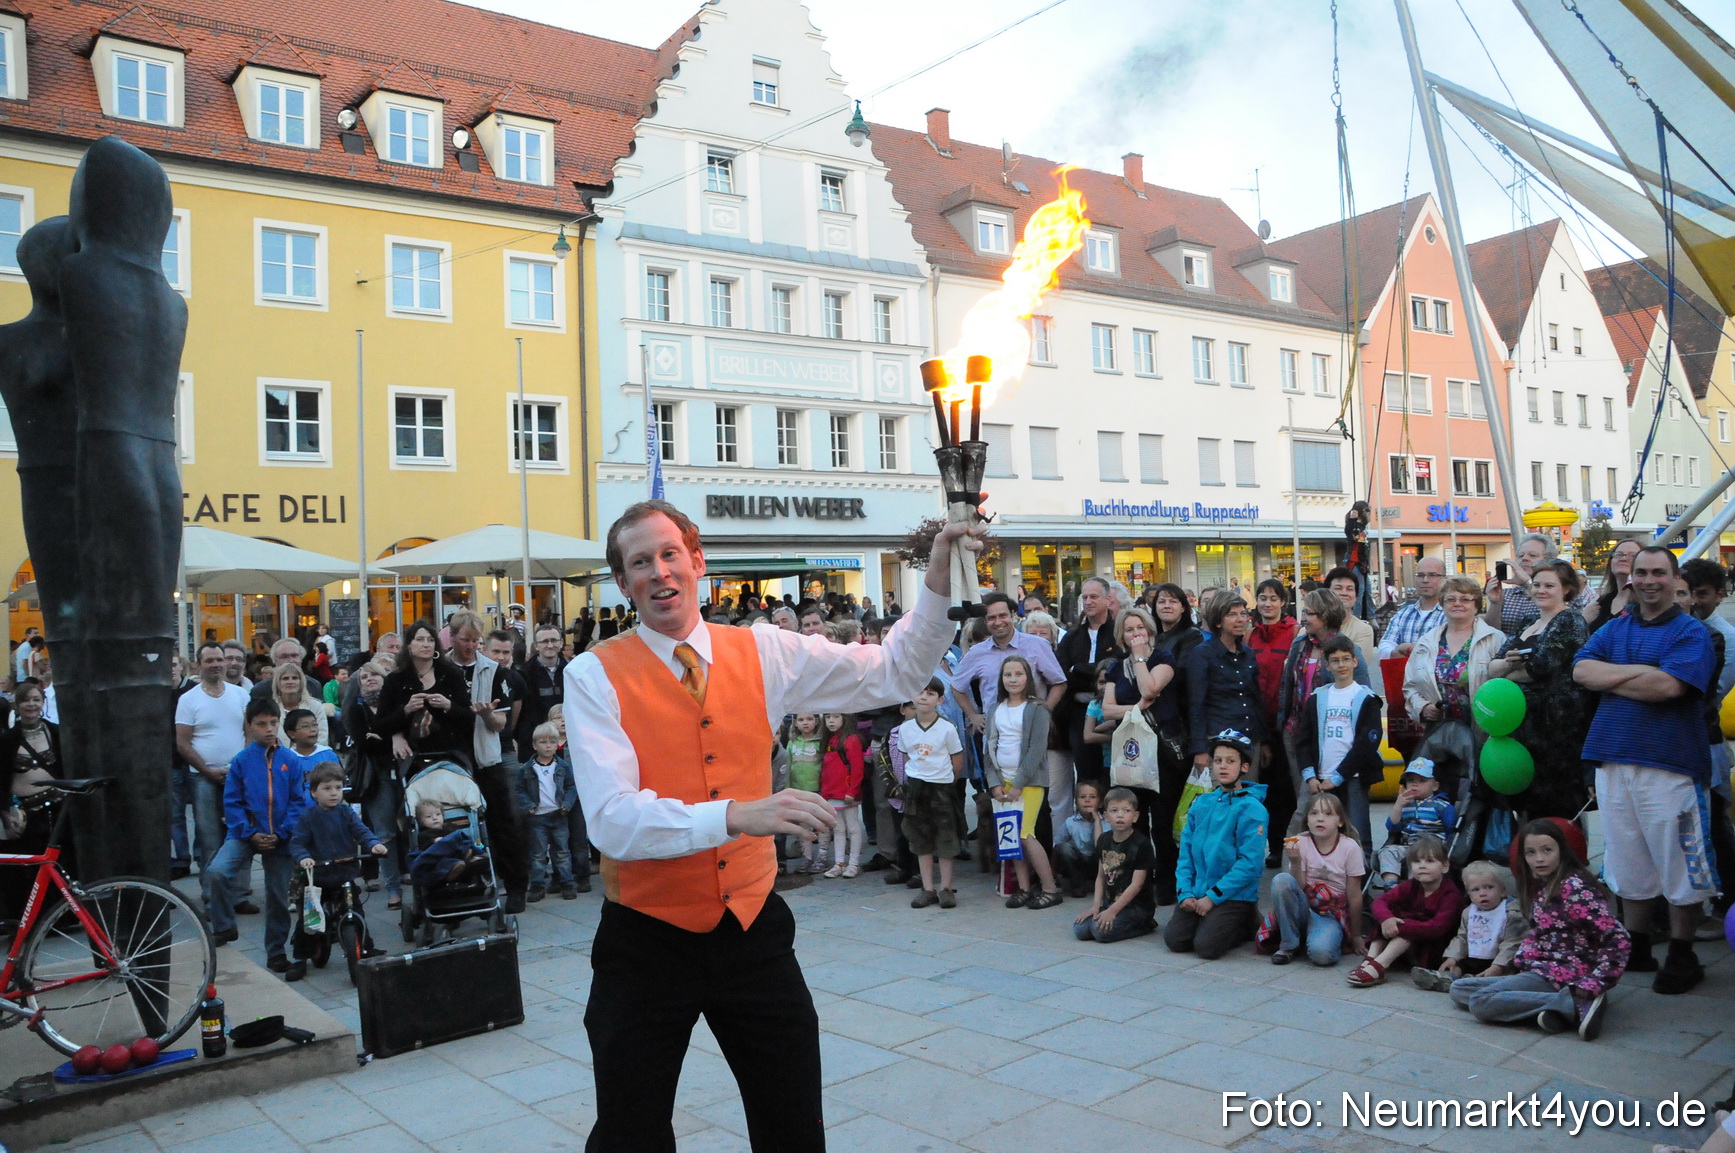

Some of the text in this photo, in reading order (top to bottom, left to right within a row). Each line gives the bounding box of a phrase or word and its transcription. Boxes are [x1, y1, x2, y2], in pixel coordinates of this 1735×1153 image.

[718, 355, 850, 383] BRILLEN WEBER
[279, 494, 346, 524] DELI
[706, 494, 867, 520] BRILLEN WEBER
[1082, 499, 1260, 523] Buchhandlung Rupprecht
[1327, 725, 1343, 738] 56
